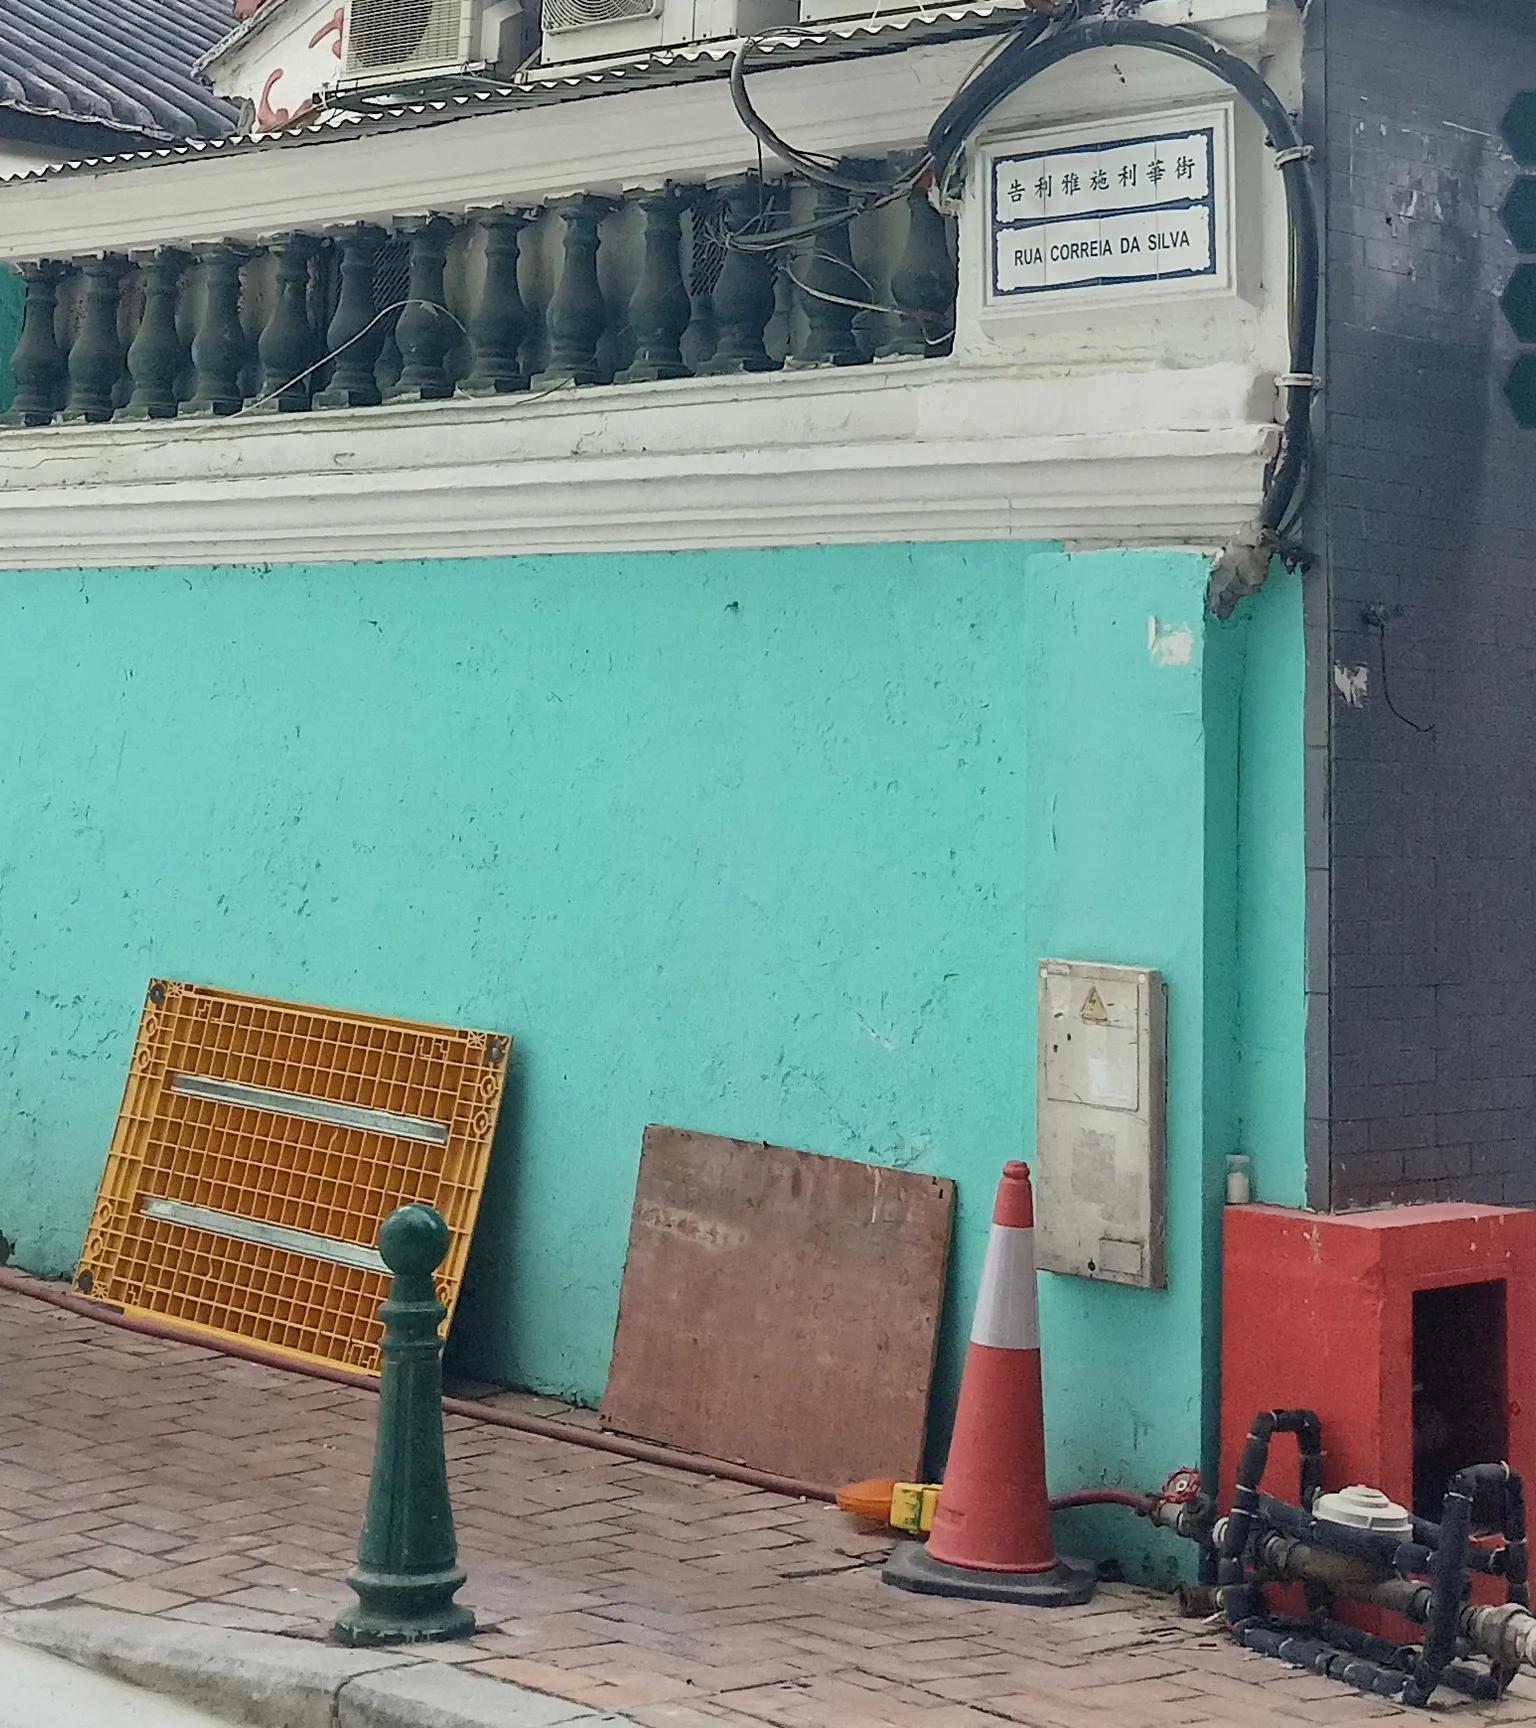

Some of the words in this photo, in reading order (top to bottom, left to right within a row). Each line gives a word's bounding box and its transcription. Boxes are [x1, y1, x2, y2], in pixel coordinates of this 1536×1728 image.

[1007, 156, 1196, 203] 告利雅施利華街
[1014, 242, 1043, 267] RUA
[1050, 237, 1113, 262] CORREIA
[1120, 235, 1141, 254] DA
[1148, 229, 1191, 252] SILVA
